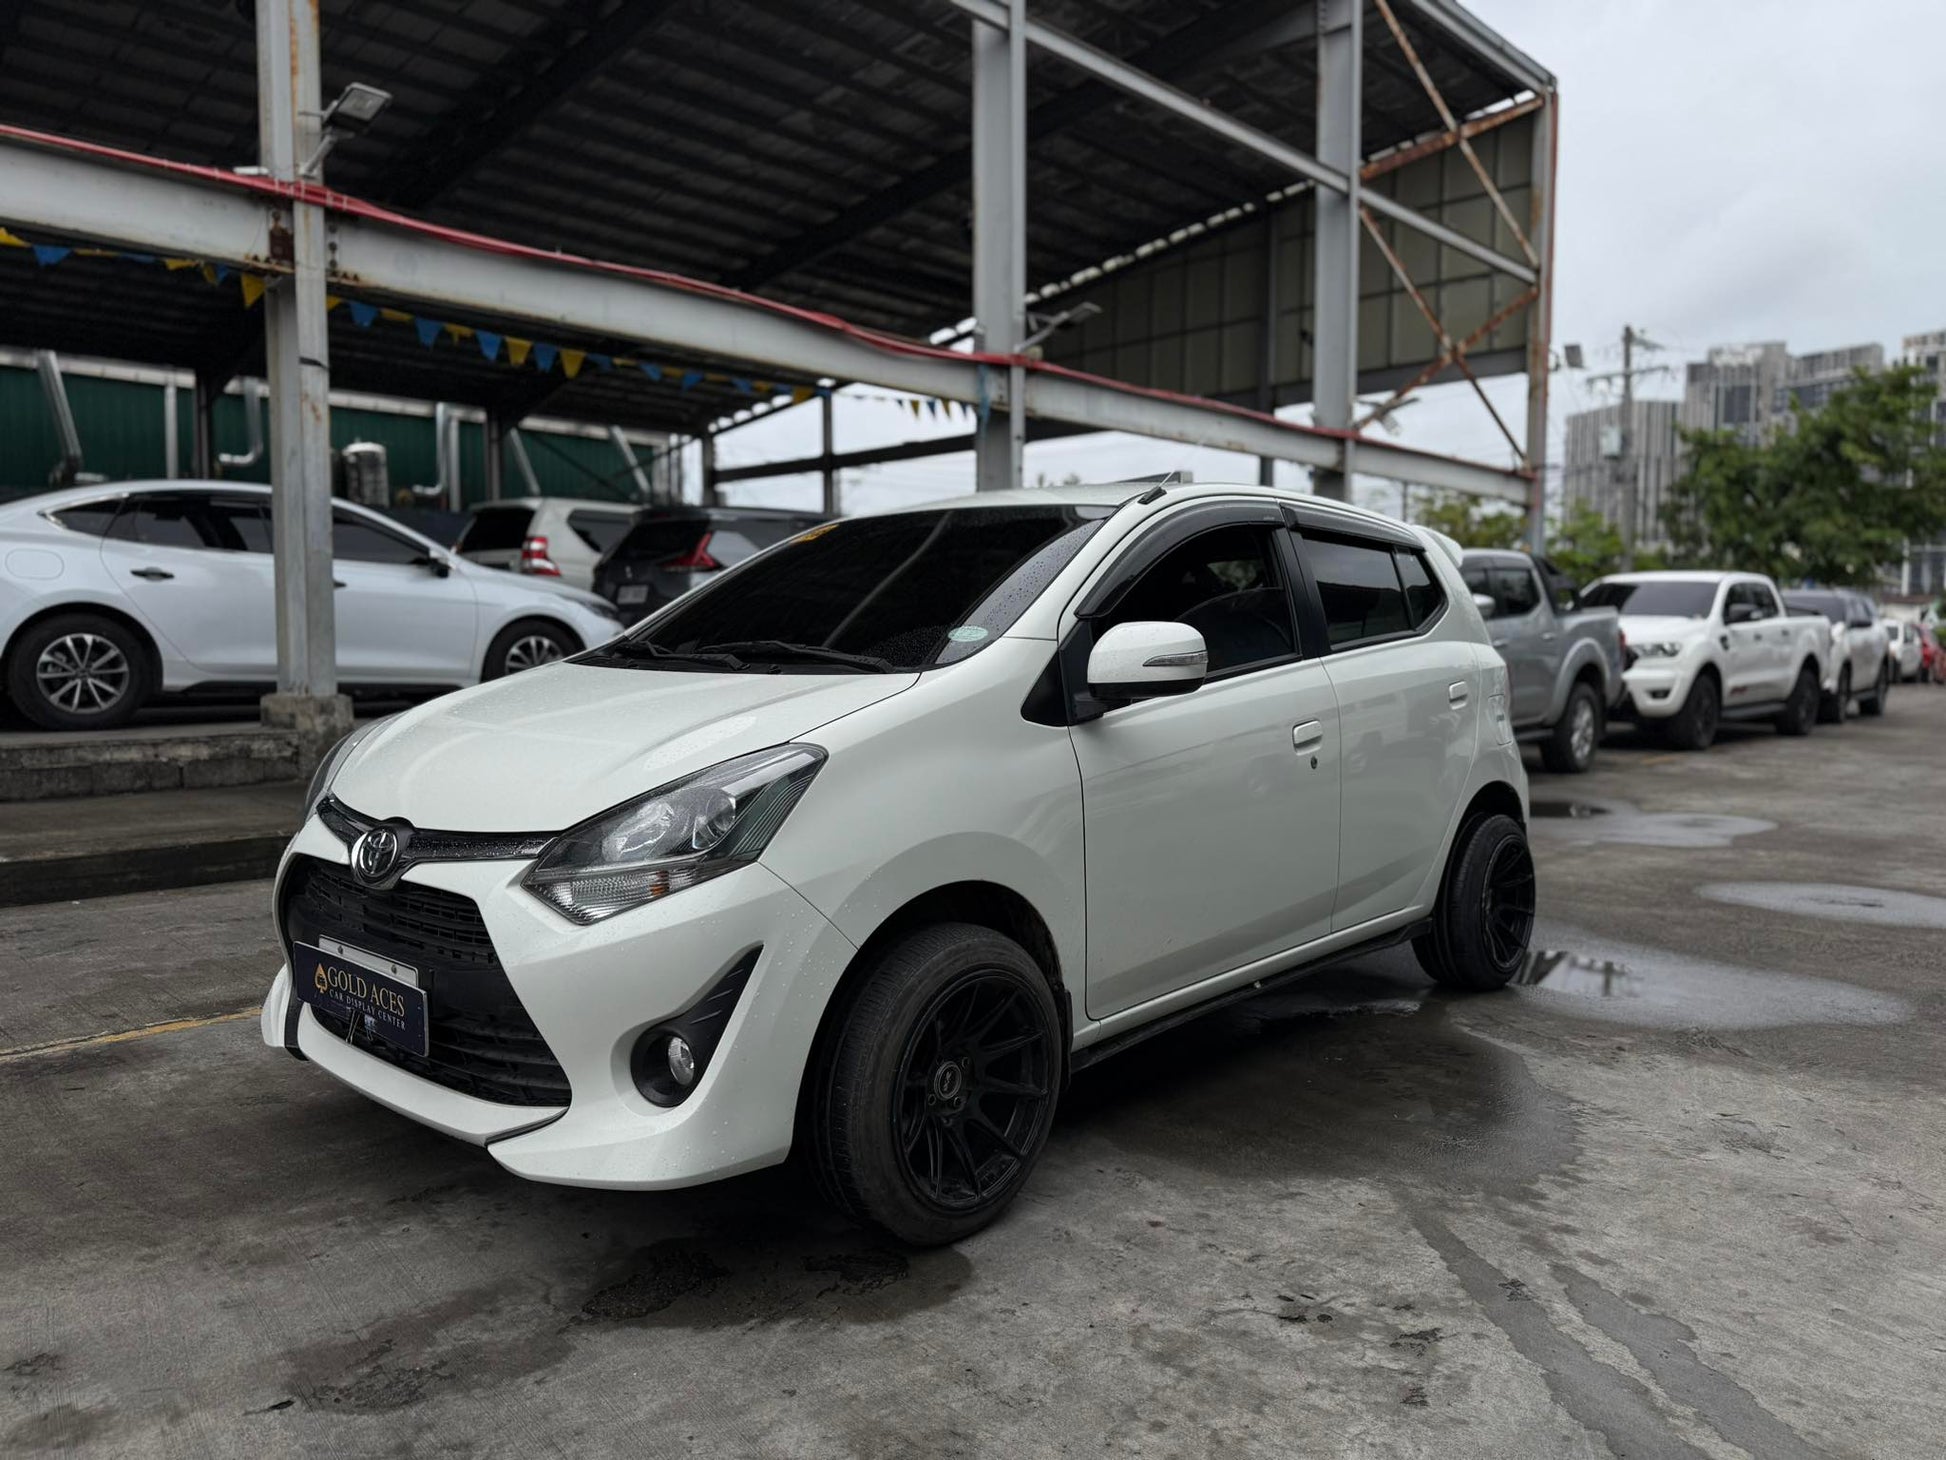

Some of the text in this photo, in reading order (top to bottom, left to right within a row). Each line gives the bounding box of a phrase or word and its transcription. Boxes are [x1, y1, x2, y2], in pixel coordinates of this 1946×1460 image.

[328, 966, 405, 1017] GOLD ACES
[329, 989, 406, 1031] CAR DISPLAY CENTER
